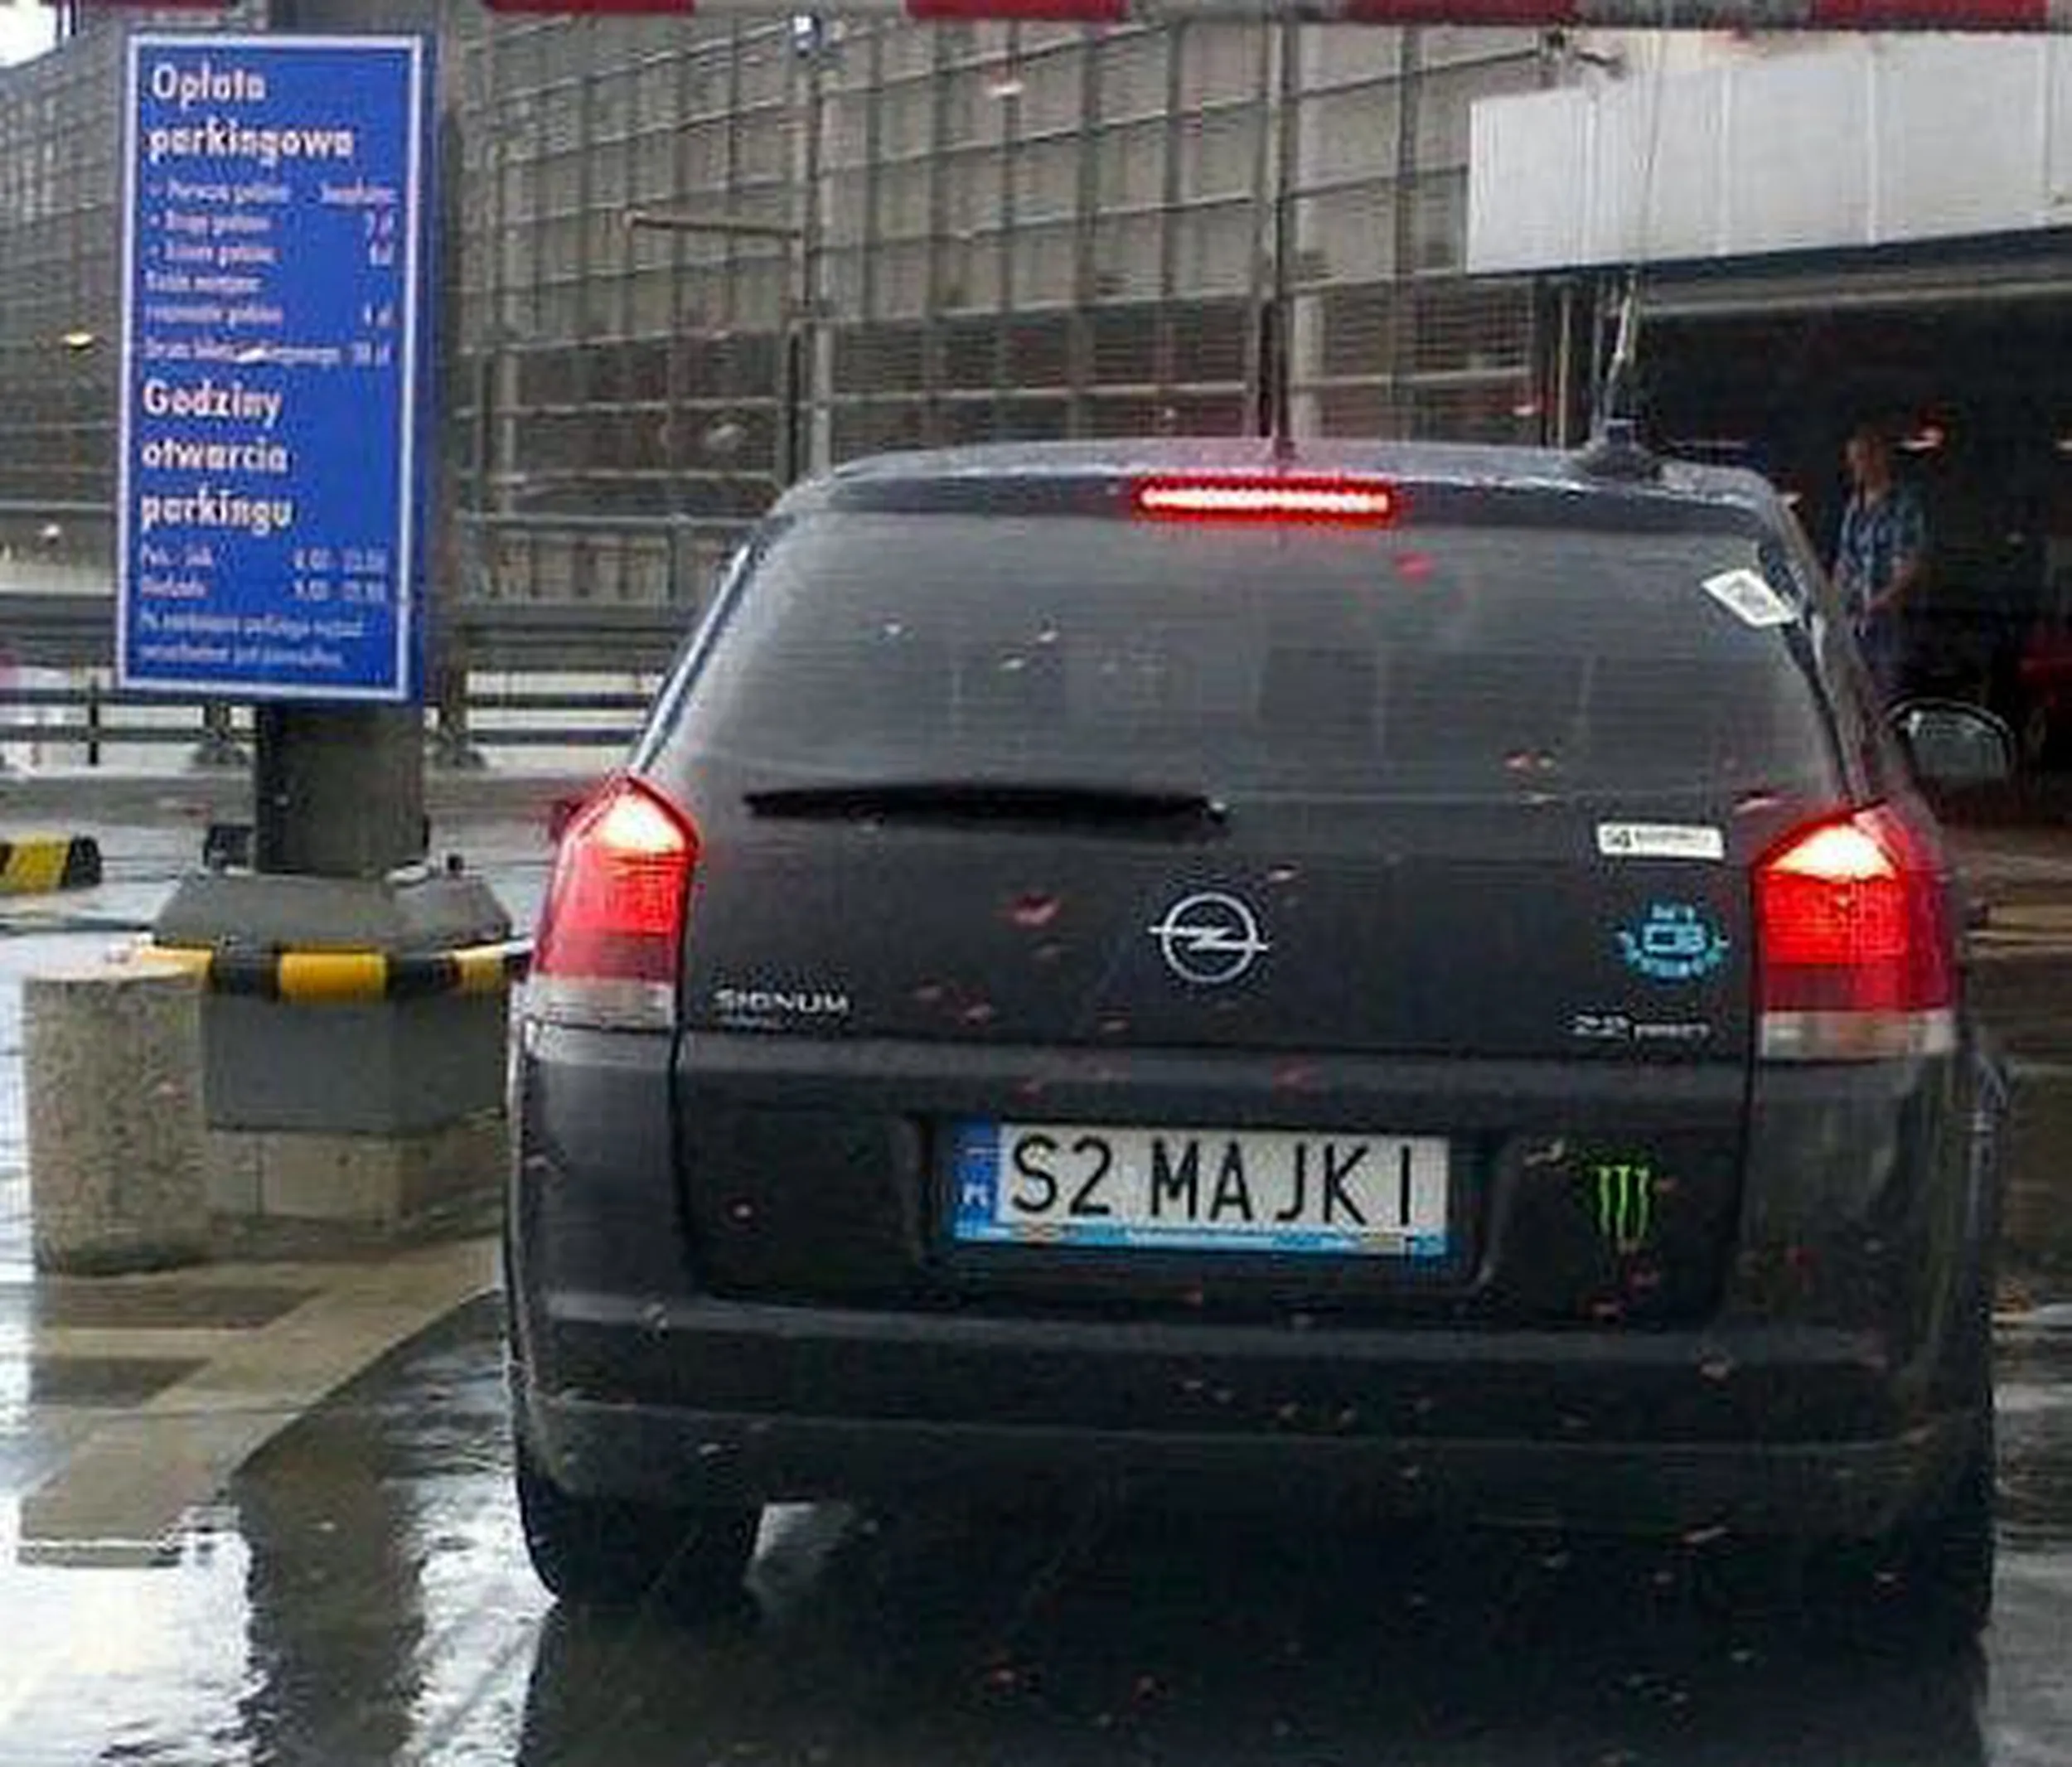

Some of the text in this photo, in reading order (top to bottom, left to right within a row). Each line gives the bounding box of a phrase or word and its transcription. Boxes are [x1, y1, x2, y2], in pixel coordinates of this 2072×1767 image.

[143, 378, 282, 428] Godziny
[141, 437, 289, 472] otwarcia
[140, 483, 293, 537] parkingu
[1010, 1134, 1112, 1217] S2
